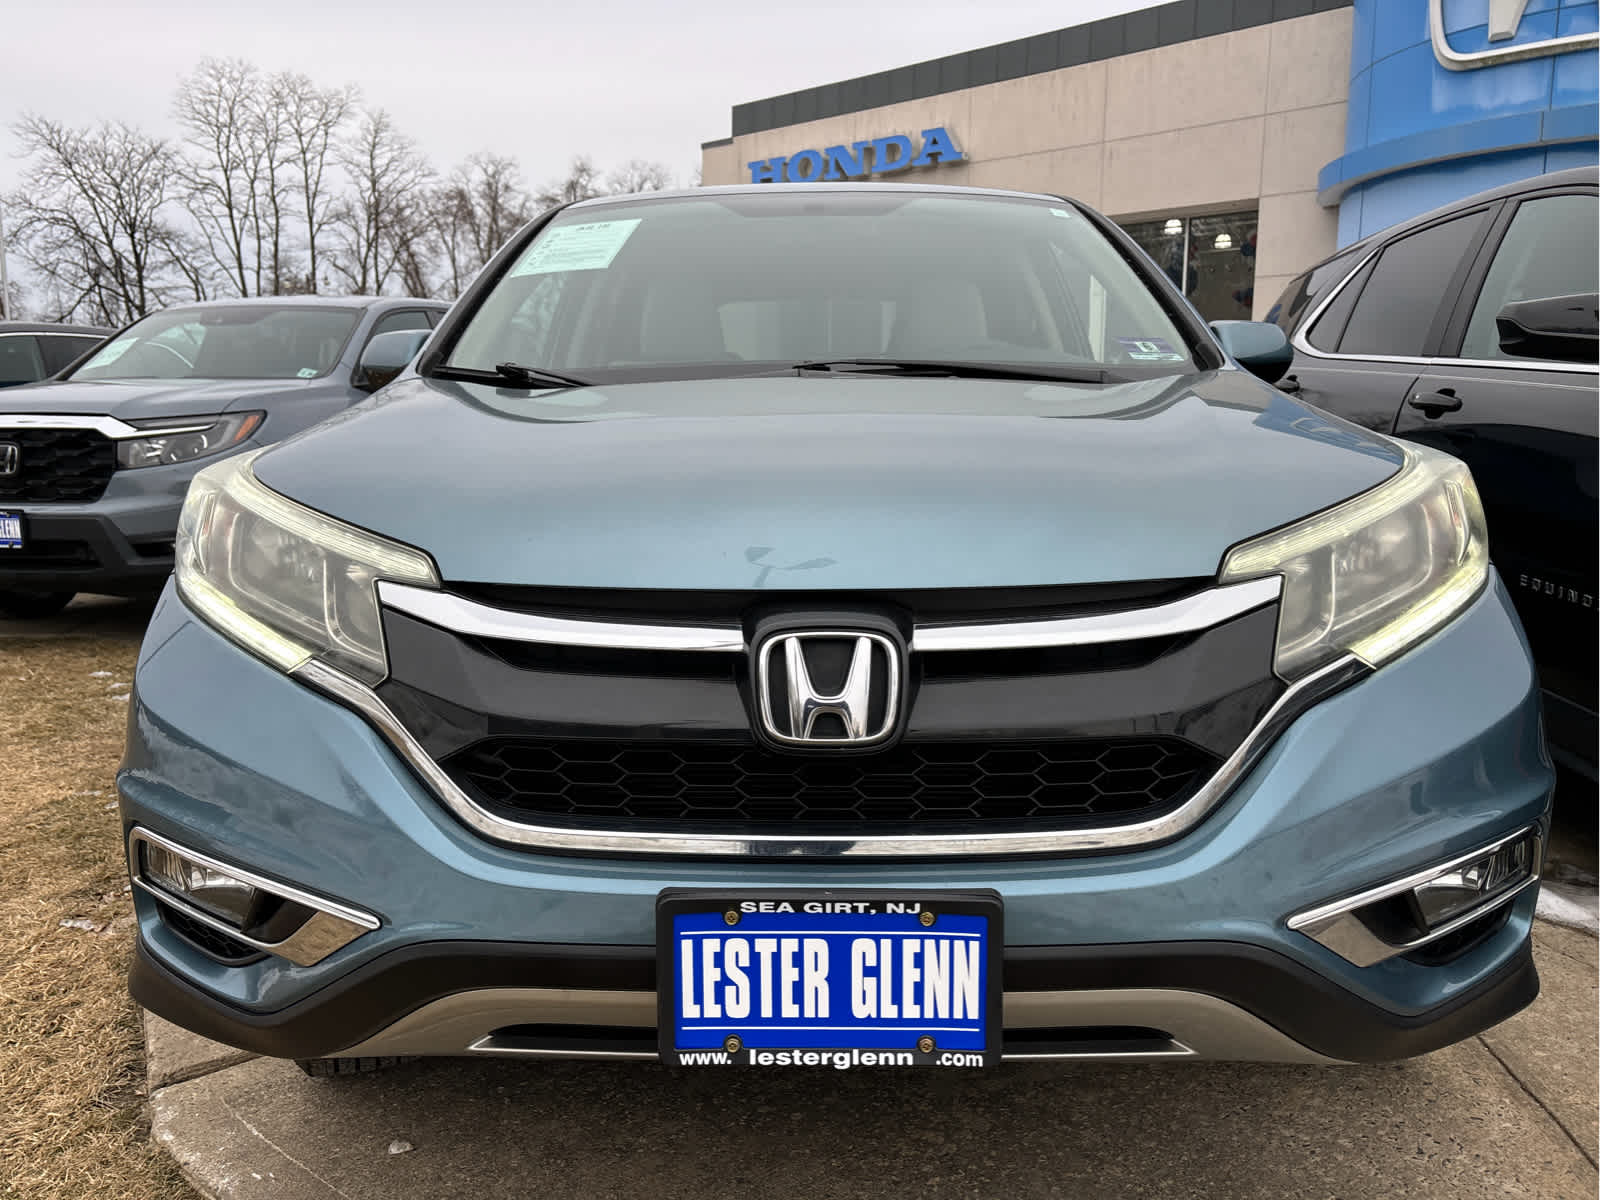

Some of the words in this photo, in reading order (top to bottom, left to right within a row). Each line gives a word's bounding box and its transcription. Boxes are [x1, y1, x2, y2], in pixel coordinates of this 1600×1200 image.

[748, 127, 963, 184] HONDA
[1520, 573, 1599, 611] EQUINO
[740, 901, 795, 913] SEA
[803, 902, 877, 915] GIRT,
[886, 902, 921, 914] NJ
[681, 937, 830, 1019] LESTER
[851, 937, 980, 1020] GLENN
[679, 1052, 733, 1066] www.
[749, 1048, 914, 1070] lesterglenn
[935, 1051, 984, 1067] .com
